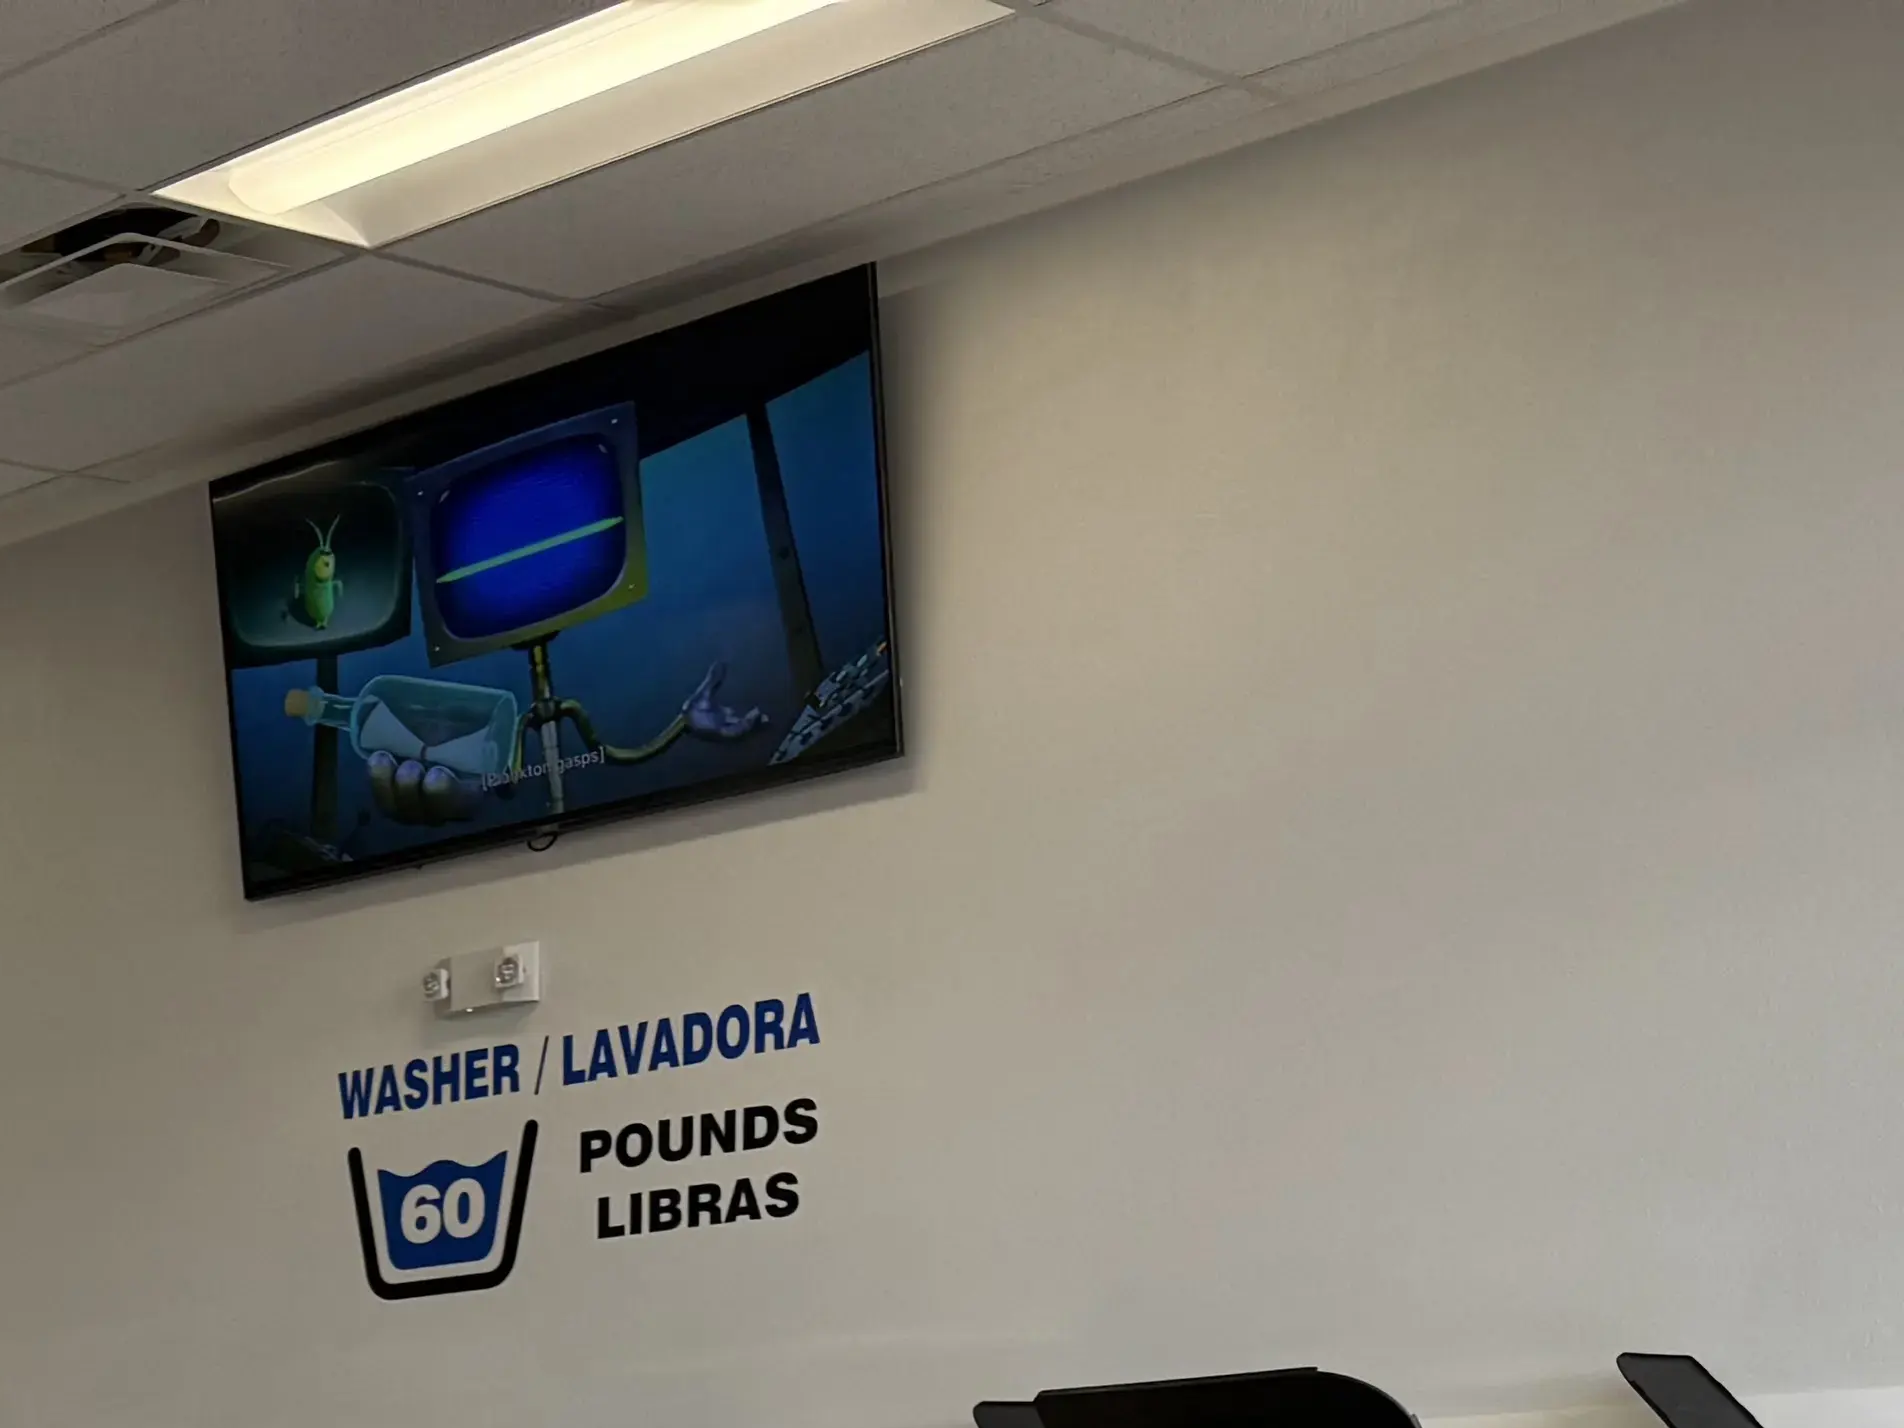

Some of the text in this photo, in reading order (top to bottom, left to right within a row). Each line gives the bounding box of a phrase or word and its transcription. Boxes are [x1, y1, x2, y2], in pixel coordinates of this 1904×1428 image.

[337, 1043, 520, 1120] WASHER
[562, 992, 820, 1087] LAVADORA
[579, 1098, 819, 1173] POUNDS
[400, 1178, 486, 1245] 60
[596, 1171, 800, 1239] LIBRAS
